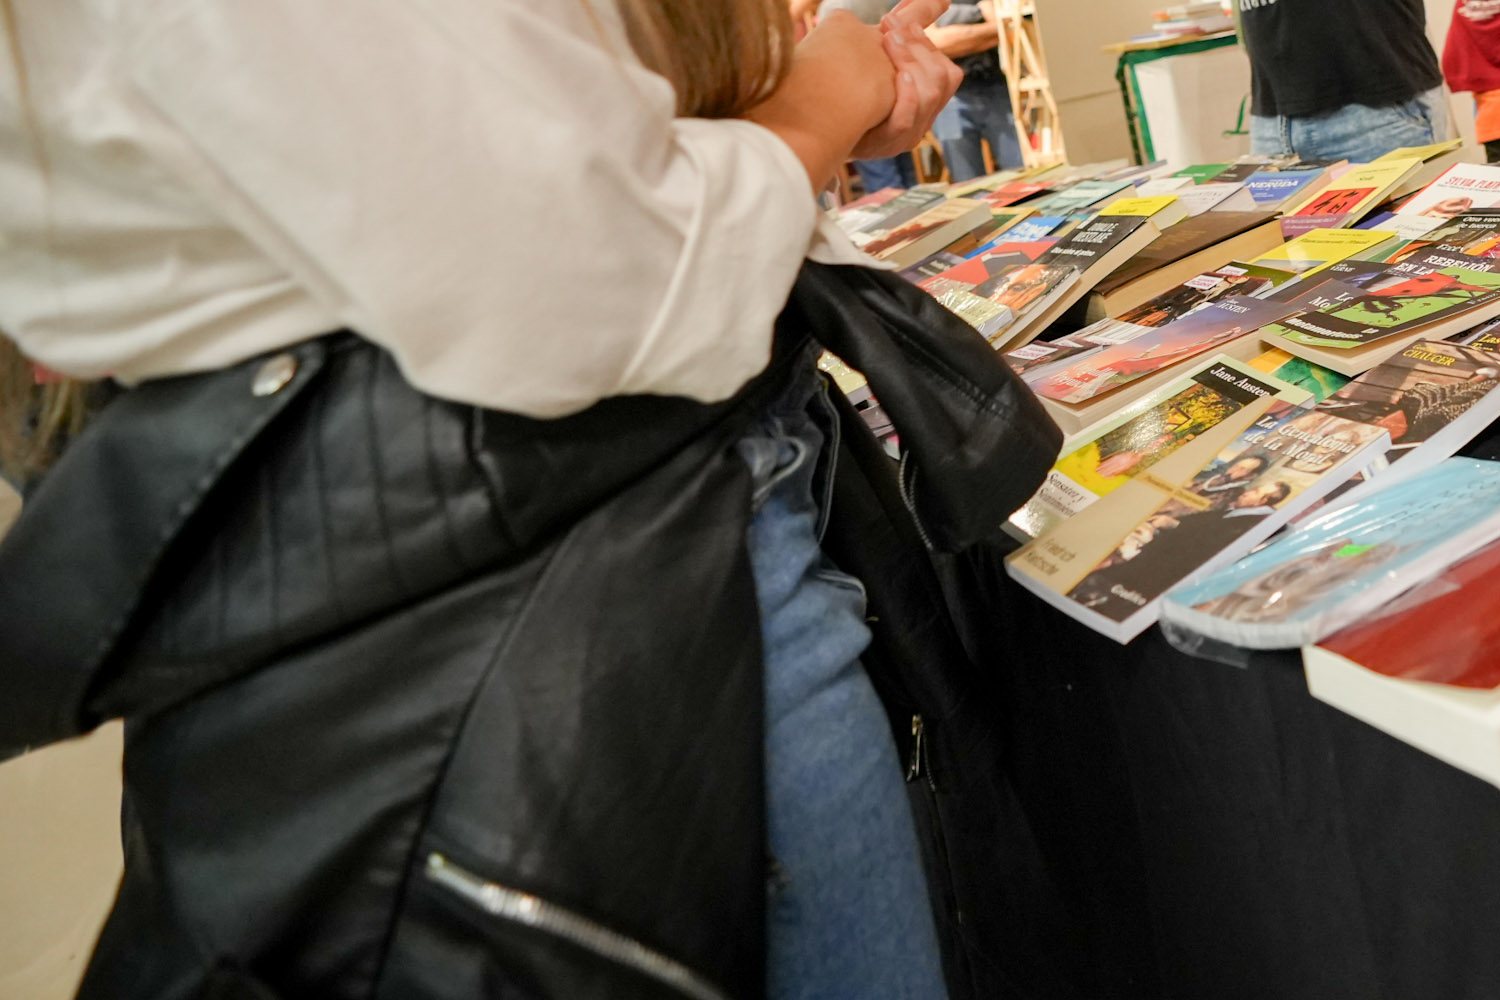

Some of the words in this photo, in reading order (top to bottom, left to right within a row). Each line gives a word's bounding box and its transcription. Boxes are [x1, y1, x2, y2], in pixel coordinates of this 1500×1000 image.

[1246, 180, 1299, 190] NERUDA
[1445, 176, 1476, 187] SYLVIA
[1394, 262, 1418, 273] EN
[1415, 266, 1437, 276] LA
[1424, 254, 1495, 273] REBELIÓN
[1284, 317, 1364, 339] Metamorfosis
[1479, 333, 1500, 345] Las
[1402, 349, 1456, 367] CHAUCER
[1210, 366, 1236, 387] Jane
[1234, 376, 1274, 398] Austen
[1256, 414, 1278, 431] La
[1244, 430, 1264, 445] de
[1264, 434, 1283, 452] la
[1283, 441, 1333, 466] Moral
[1047, 471, 1080, 500] Sensatez
